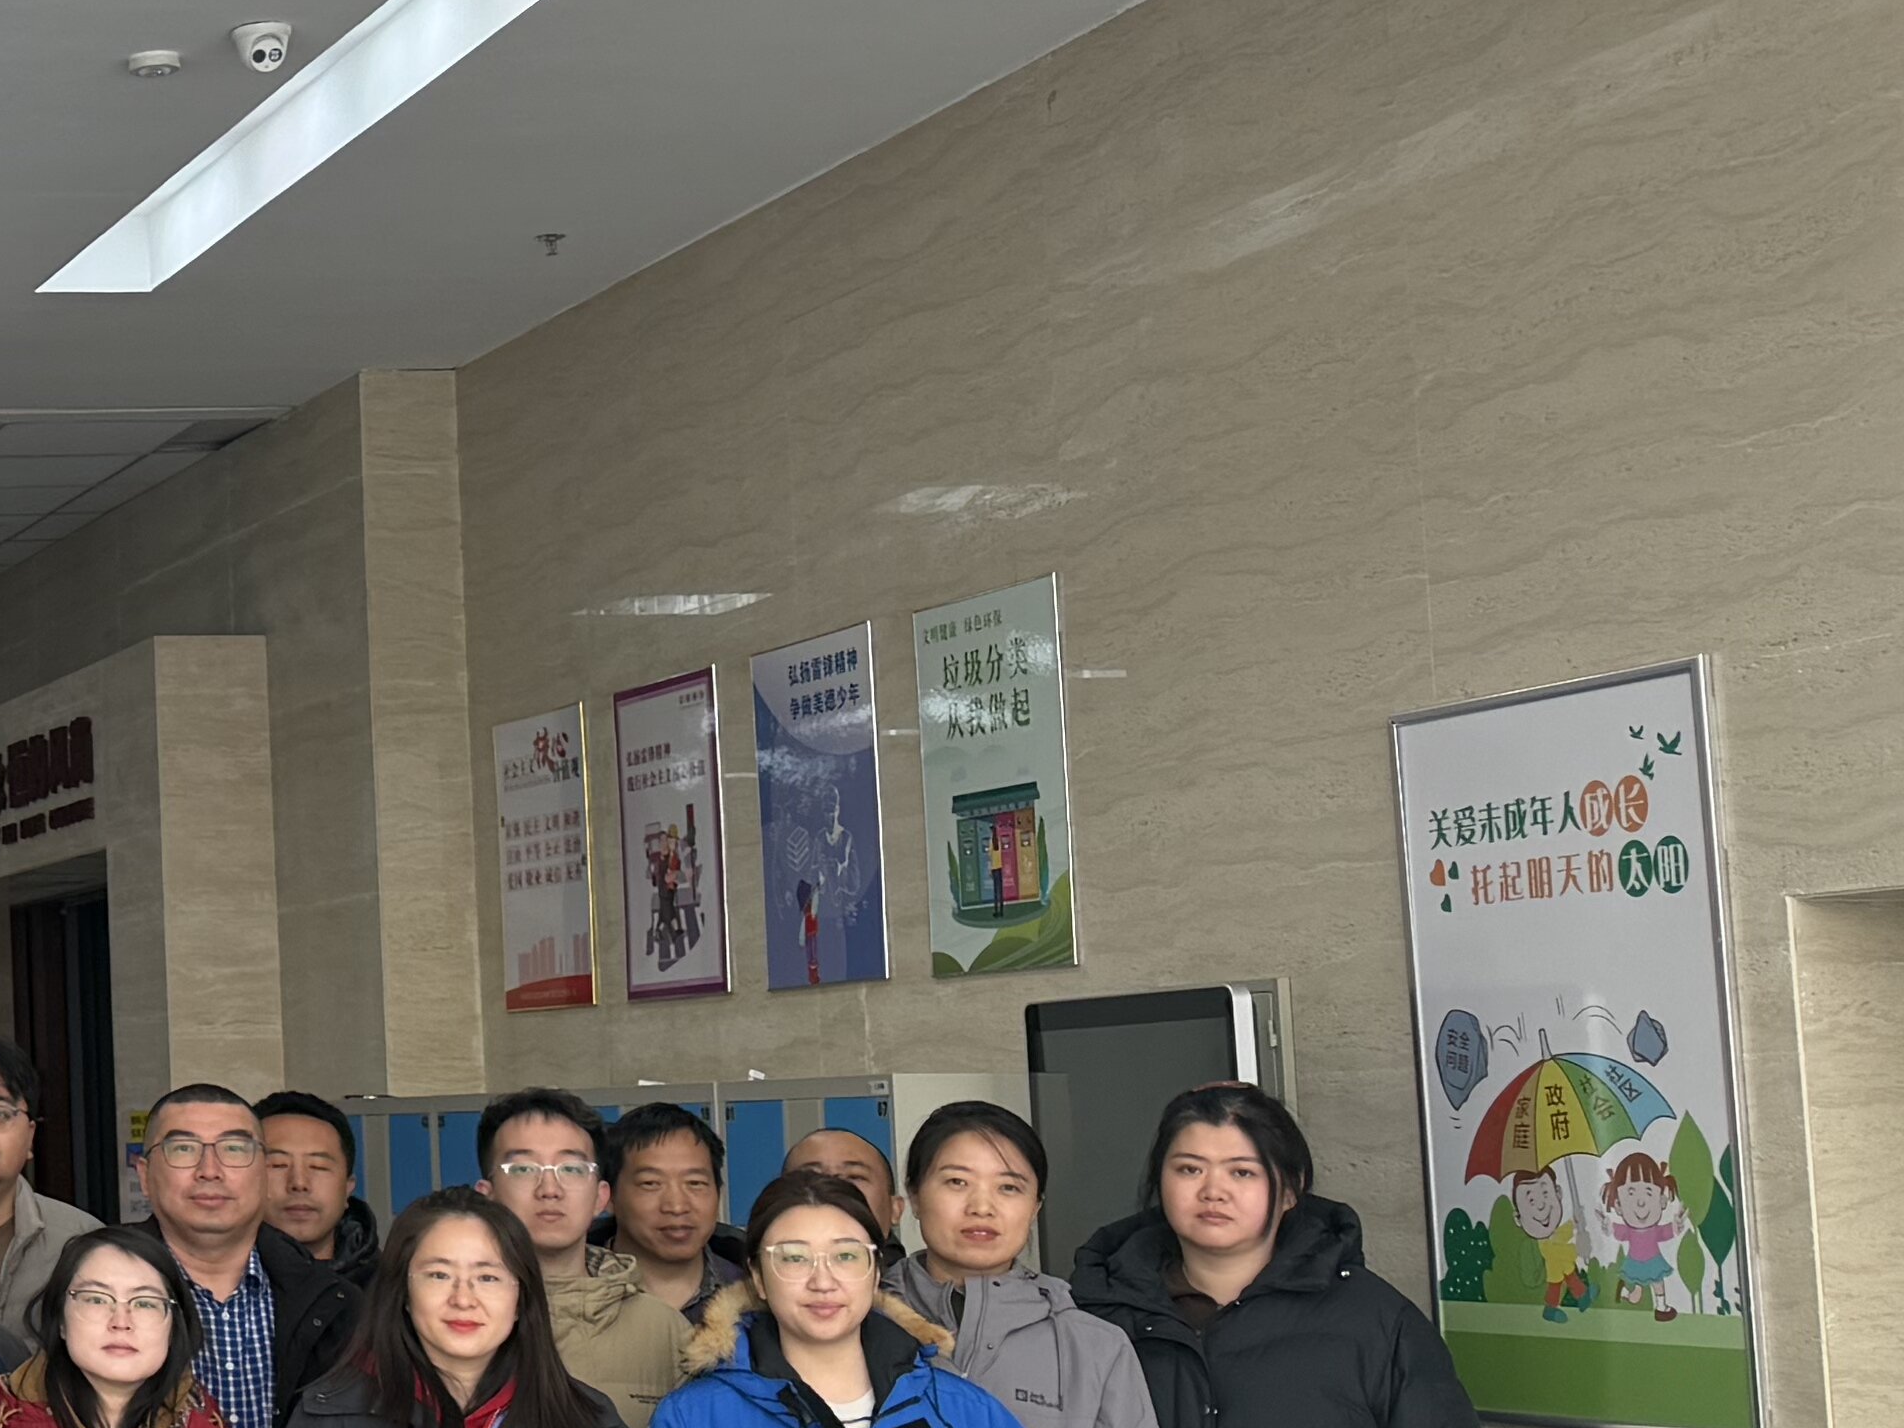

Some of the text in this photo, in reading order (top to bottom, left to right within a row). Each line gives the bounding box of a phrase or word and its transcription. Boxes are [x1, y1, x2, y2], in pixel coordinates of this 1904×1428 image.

[788, 646, 858, 688] 弘扬雷锋精神
[943, 636, 1028, 691] 垃圾分类
[946, 686, 1031, 741] 从我做起
[1428, 783, 1645, 850] 关爱未成年人成长
[1470, 843, 1687, 906] 托起明天的太阳
[1544, 1083, 1570, 1141] 政府
